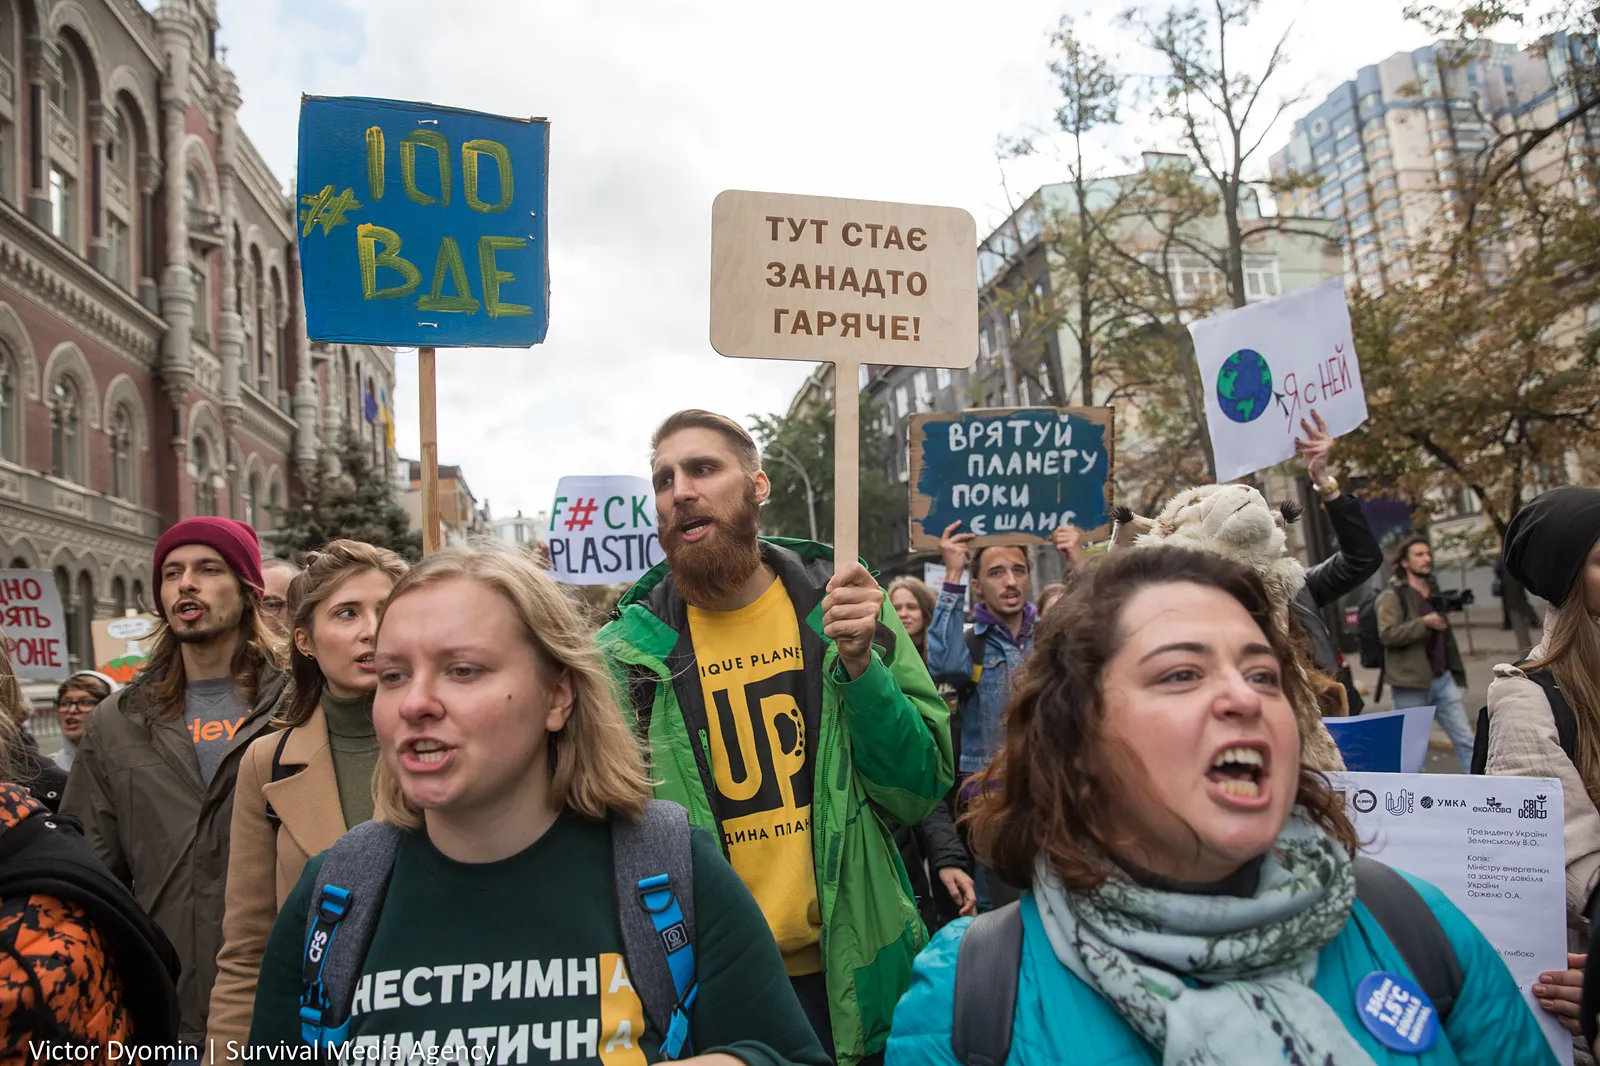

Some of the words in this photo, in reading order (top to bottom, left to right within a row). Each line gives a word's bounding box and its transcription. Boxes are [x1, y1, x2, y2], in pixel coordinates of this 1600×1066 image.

[366, 126, 514, 214] 100
[765, 215, 829, 244] ТУТ
[841, 221, 928, 252] СТАЄ
[765, 261, 928, 299] ЗАНАДТО
[774, 308, 921, 342] ГАРЯЧЕ!
[949, 414, 1072, 452] ВРЯТУЙ
[967, 449, 1098, 478] ПЛАНЕТУ
[952, 483, 1029, 509] ПОКИ
[549, 495, 652, 532] F#CK
[0, 606, 51, 628] ЯТЬ
[1437, 799, 1467, 808] УМКА
[1467, 827, 1514, 838] Президенту
[1515, 830, 1548, 838] України
[1467, 837, 1520, 847] Зеленському
[1467, 863, 1501, 872] Міністру
[1502, 866, 1550, 874] енергетики
[1478, 874, 1509, 882] захисту
[1467, 881, 1499, 889] України
